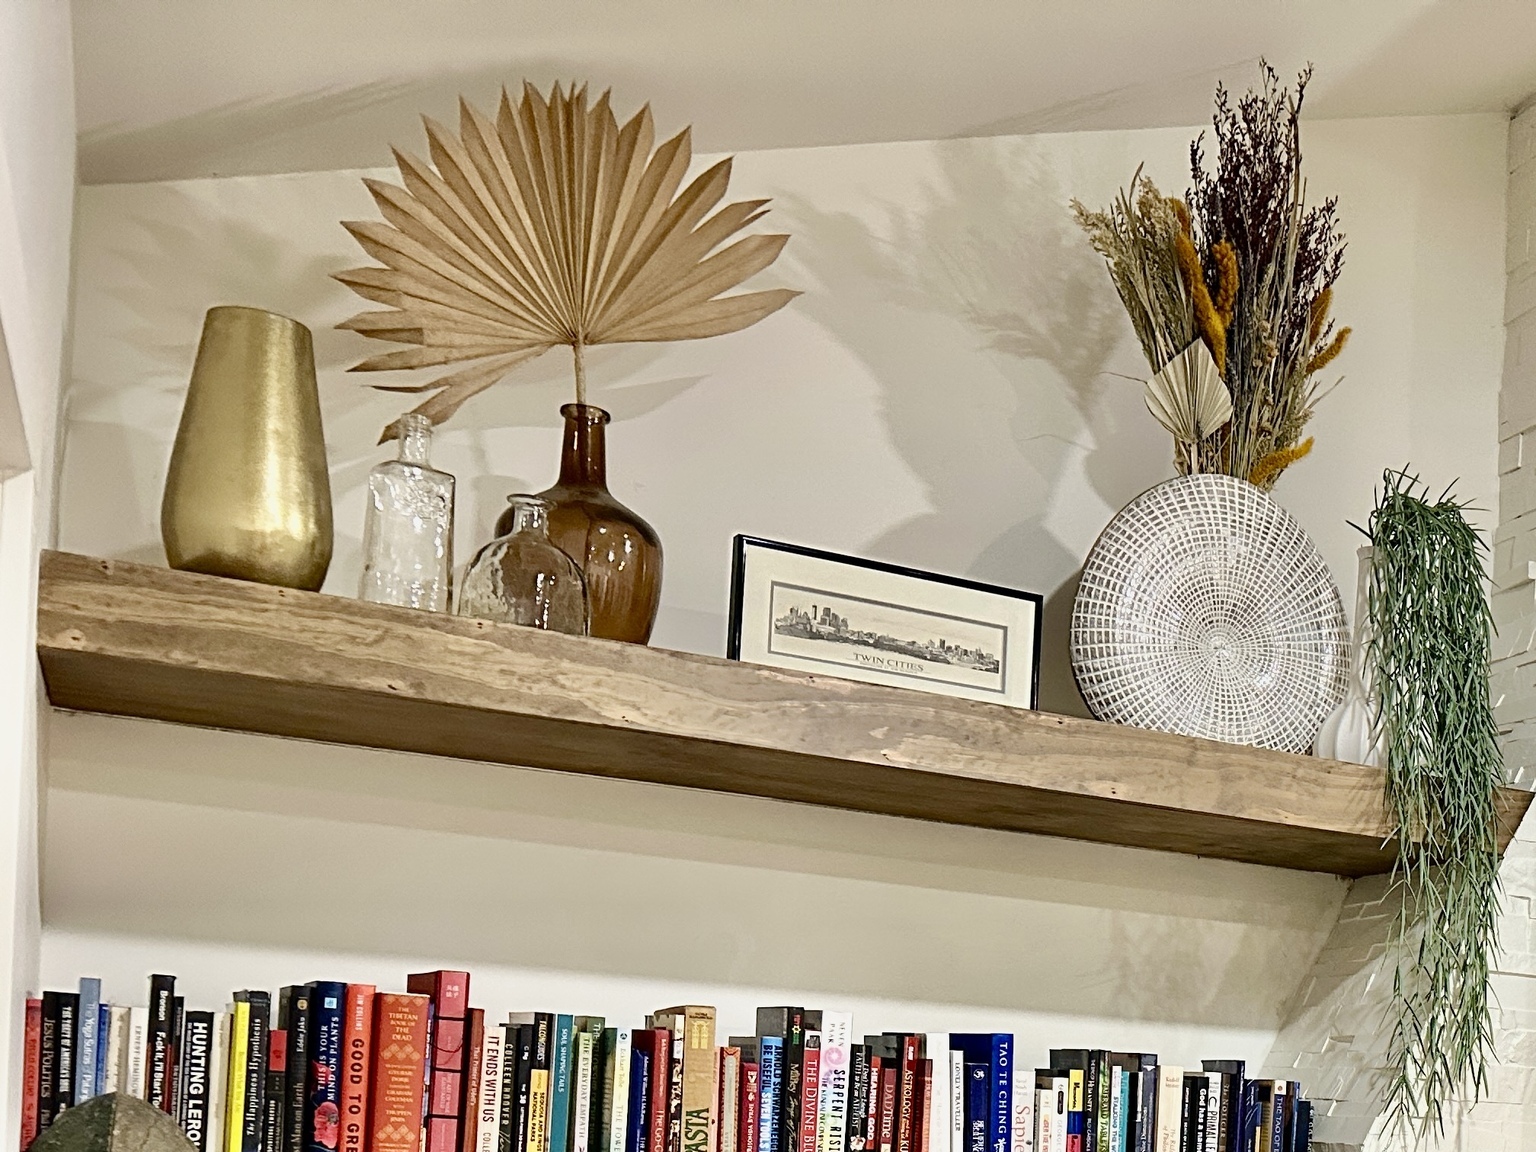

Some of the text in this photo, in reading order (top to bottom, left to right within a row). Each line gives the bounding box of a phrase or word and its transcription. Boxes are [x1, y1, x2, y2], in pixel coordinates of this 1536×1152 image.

[853, 652, 884, 664] TWIN
[887, 660, 924, 672] CITIES
[356, 994, 364, 1006] JIM
[355, 1007, 364, 1031] COLLINS
[82, 1003, 94, 1065] The Yoga Sutras
[134, 1026, 142, 1054] ERNEST
[154, 990, 168, 1094] Bronson Start
[487, 1036, 500, 1046] IT
[560, 1028, 569, 1045] SOUL
[41, 1017, 56, 1098] JESUS POLITICS
[189, 1022, 208, 1095] HUNTING
[317, 1025, 328, 1091] THIS IS YOUR
[327, 1016, 339, 1100] MIND ON PLANTS
[351, 1038, 364, 1085] GOOD
[485, 1048, 499, 1076] ENDS
[559, 1046, 567, 1073] SHAPING
[763, 1045, 772, 1056] BE
[773, 1045, 782, 1079] ARNOLD
[855, 1052, 863, 1075] FAITH
[245, 1018, 261, 1135] The Happiness Hypothesis
[471, 1060, 480, 1079] Printer
[581, 1057, 589, 1100] EVERYDAY
[761, 1058, 772, 1091] USEFUL
[806, 1060, 818, 1083] THE
[292, 1082, 303, 1108] Earth
[482, 1078, 497, 1106] WITH
[501, 1043, 514, 1125] COLLEEN HOOVER
[831, 1069, 846, 1121] SERPENT
[868, 1067, 878, 1115] HEARING
[902, 1069, 913, 1119] ASTROLOGY
[998, 1042, 1008, 1134] TAO TE CHING
[1198, 1088, 1207, 1102] God
[294, 1110, 302, 1121] on
[349, 1094, 361, 1115] TO
[482, 1109, 494, 1123] US
[615, 1105, 623, 1123] THE
[655, 1109, 665, 1127] The
[746, 1103, 755, 1123] BYRNE
[760, 1092, 771, 1120] SEVEN
[805, 1087, 817, 1132] DIVINE
[1111, 1096, 1119, 1126] STALKING
[1197, 1103, 1206, 1123] has
[292, 1123, 302, 1144] Man
[578, 1103, 587, 1138] EMPATH
[867, 1117, 876, 1140] GOD
[1205, 1110, 1218, 1140] PRIMAL
[1274, 1116, 1282, 1133] TAO
[745, 1124, 754, 1152] RHONDA
[759, 1121, 770, 1149] TOOLS
[1274, 1135, 1281, 1147] OF
